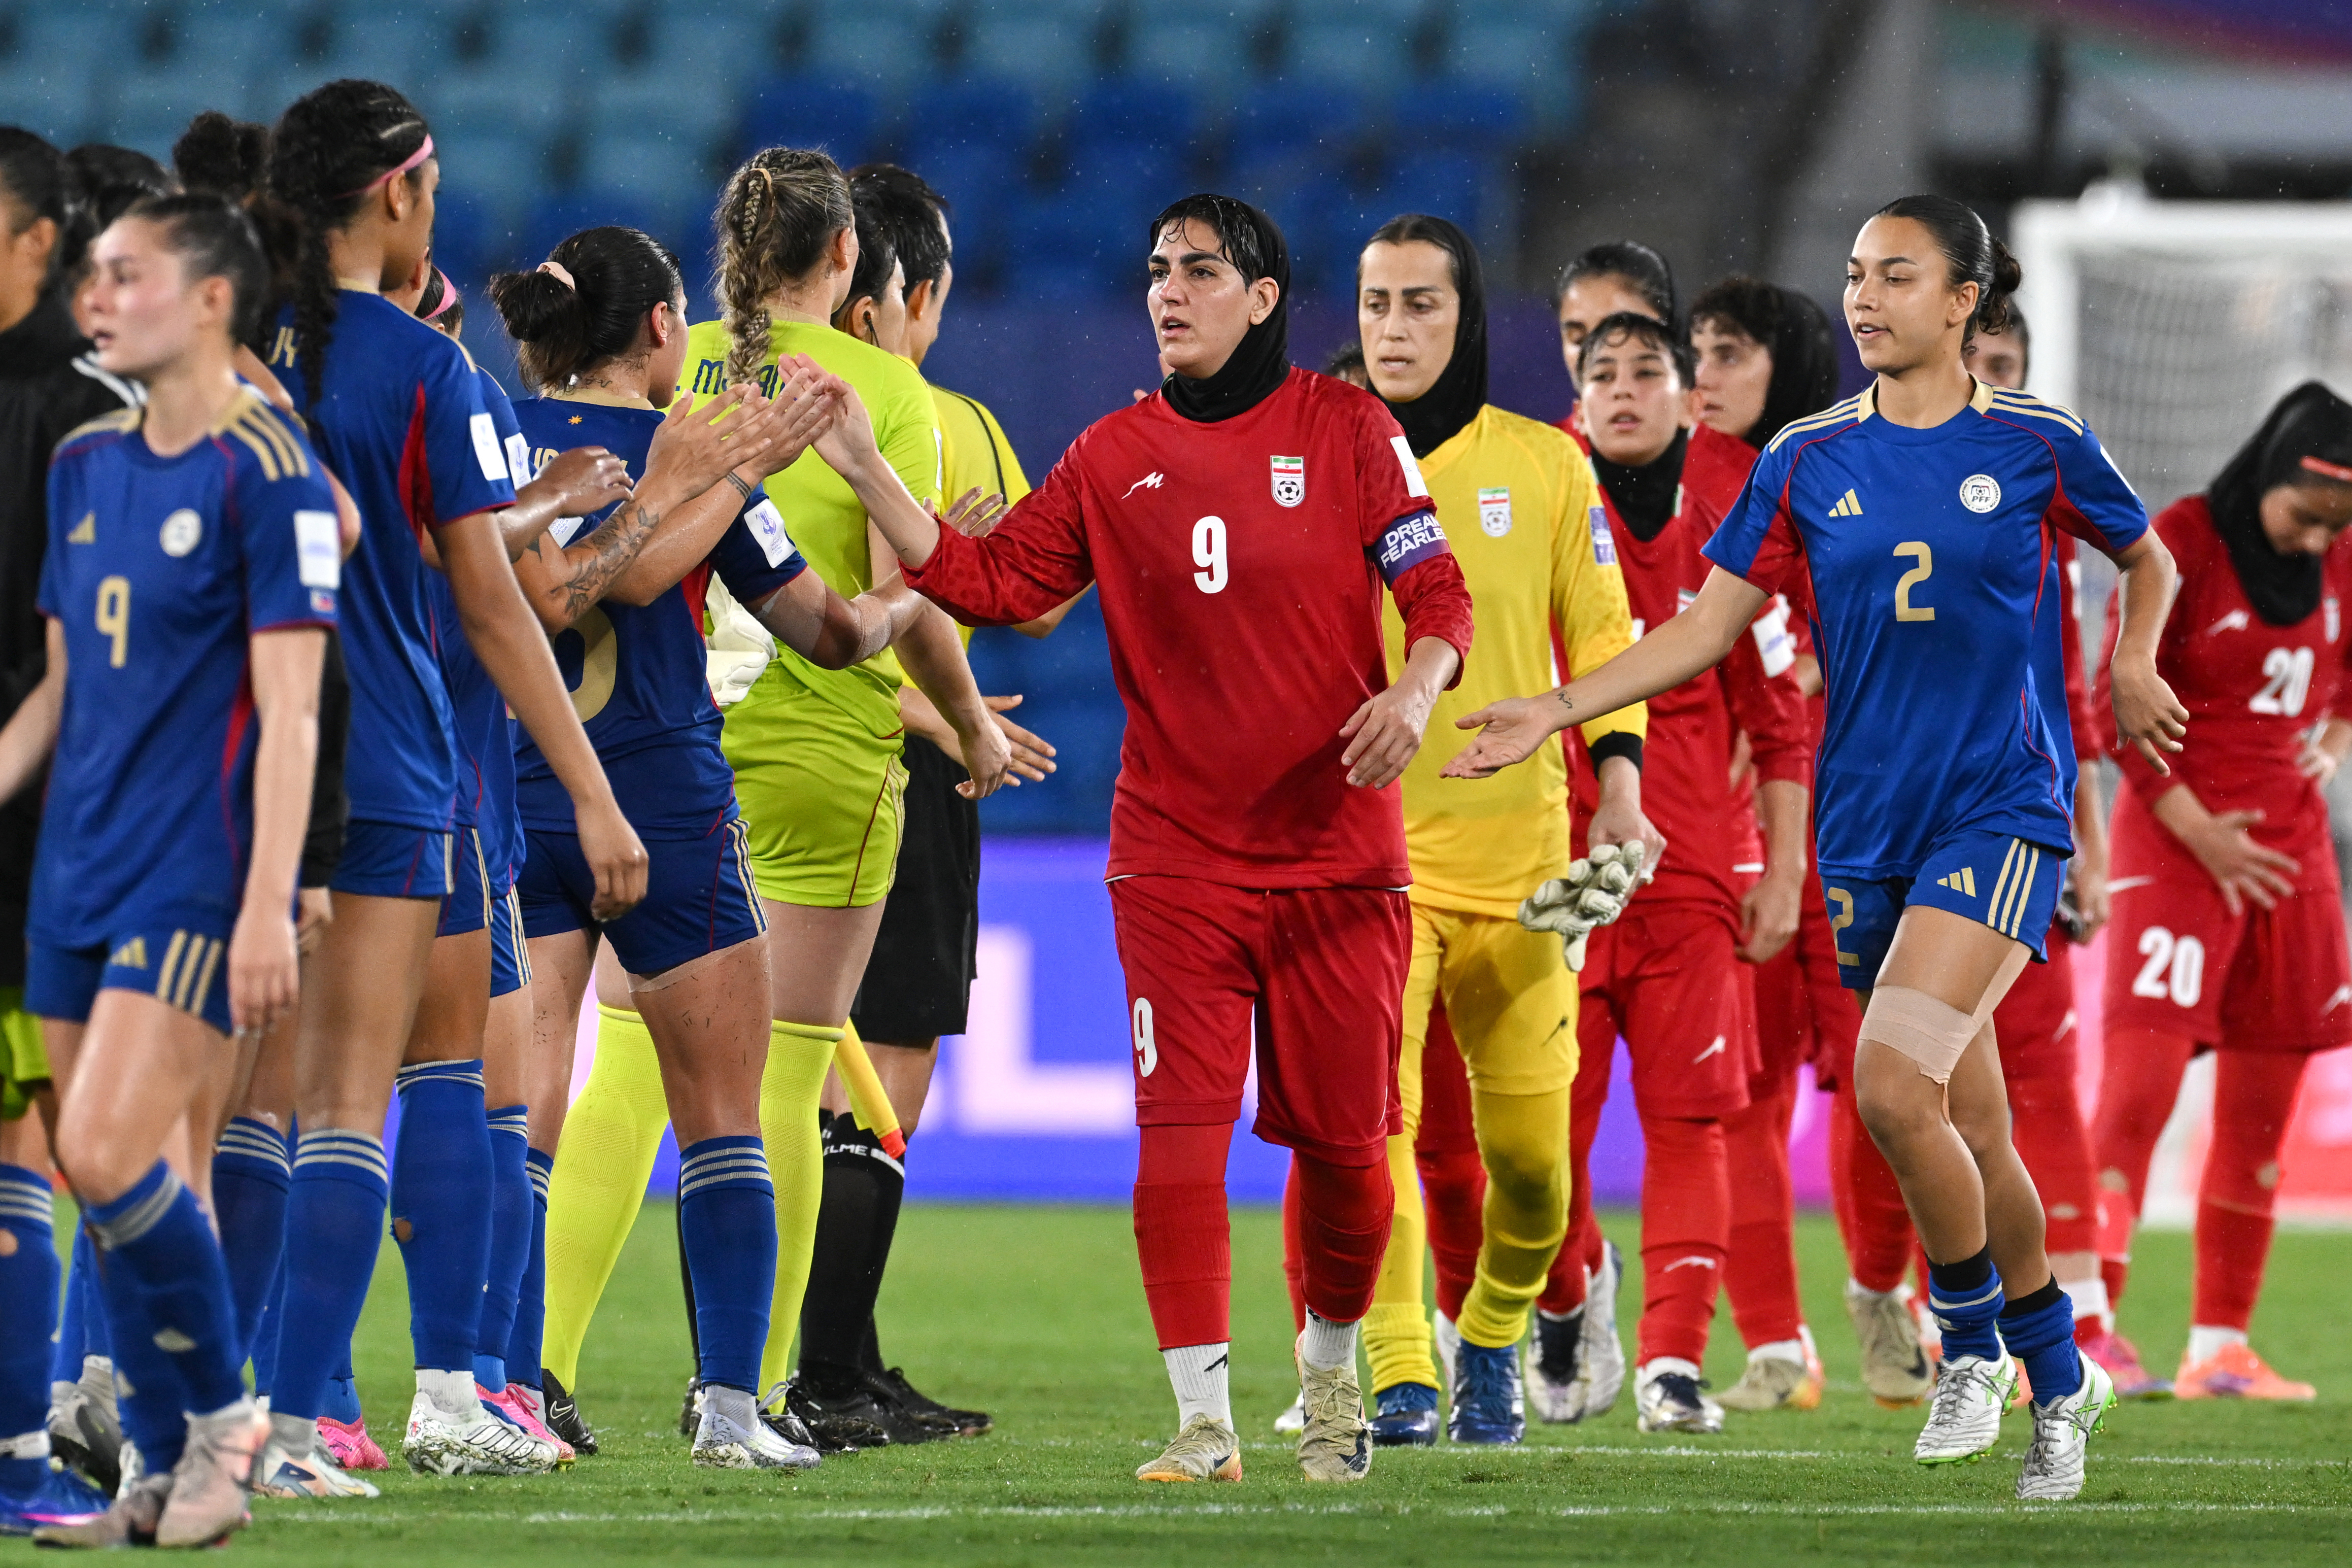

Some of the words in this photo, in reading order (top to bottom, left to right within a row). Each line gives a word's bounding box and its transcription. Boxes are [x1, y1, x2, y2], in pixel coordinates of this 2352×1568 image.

[1192, 516, 1229, 594] 9
[1893, 541, 1935, 622] 2
[95, 576, 131, 668] 9
[2249, 646, 2315, 717] 20
[1826, 887, 1860, 966] 2
[2132, 926, 2205, 1008] 20
[1133, 997, 1158, 1078] 9
